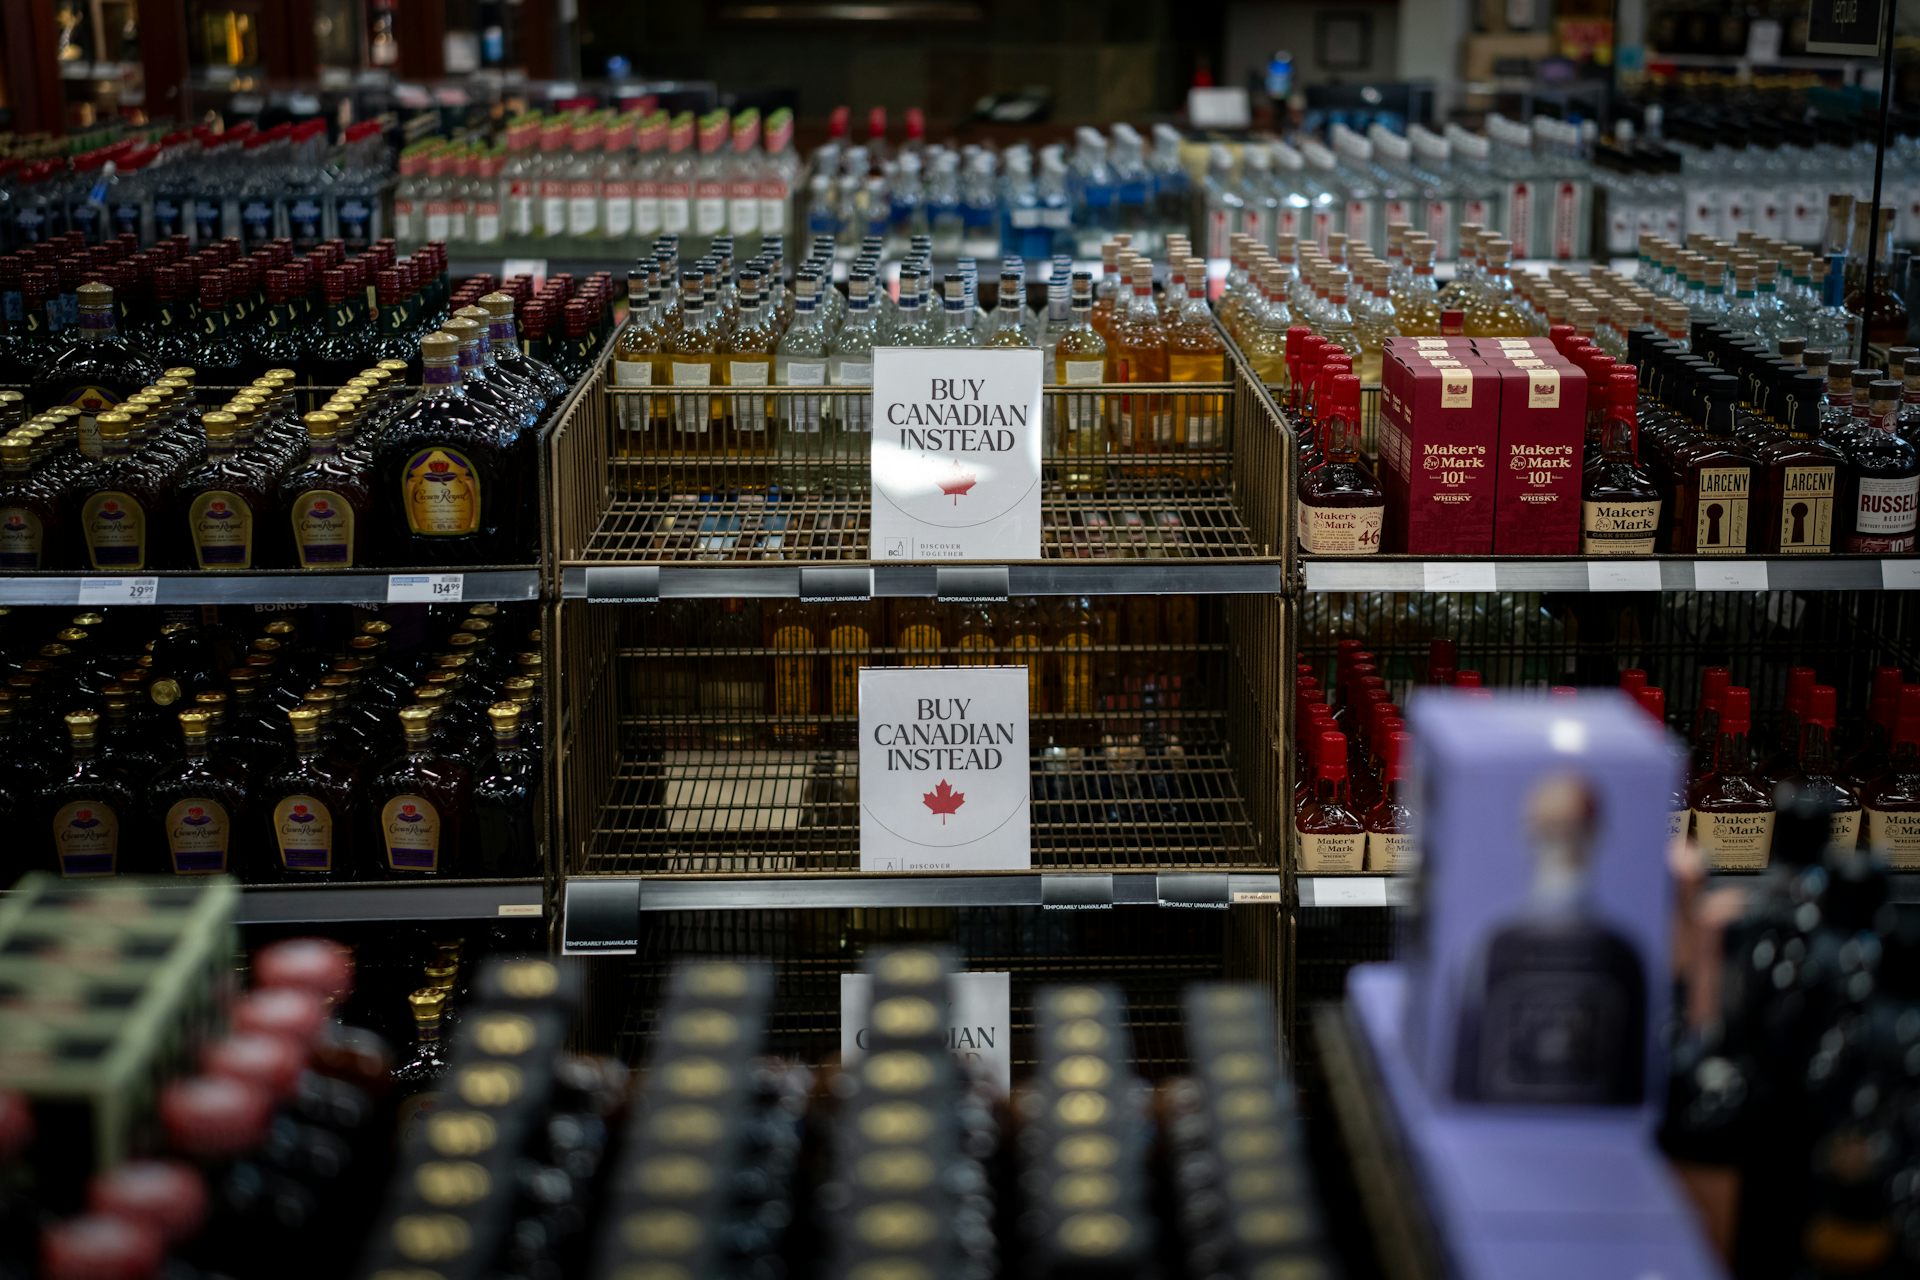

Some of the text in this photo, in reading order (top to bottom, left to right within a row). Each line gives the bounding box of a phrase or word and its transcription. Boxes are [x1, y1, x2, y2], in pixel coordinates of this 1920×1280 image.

[931, 378, 985, 401] BUY
[887, 403, 1028, 426] CANADIAN
[900, 428, 1015, 452] INSTEAD
[1423, 444, 1486, 455] Maker's
[1510, 444, 1573, 455] Maker's
[1440, 457, 1485, 468] Mark
[1527, 457, 1572, 468] Mark
[1441, 471, 1466, 484] 101
[1528, 471, 1553, 484] 101
[1701, 474, 1748, 492] LARCENY
[1785, 472, 1834, 491] LARCENY
[1314, 511, 1357, 520] Maker's
[1597, 507, 1655, 518] Maker's
[1325, 521, 1355, 529] Mark
[1612, 519, 1653, 530] Mark
[1358, 528, 1380, 545] 46
[917, 698, 971, 720] BUY
[874, 723, 1015, 746] CANADIAN
[887, 748, 1003, 771] INSTEAD
[1713, 815, 1766, 824] Maker's
[1728, 826, 1765, 834] Mark
[855, 1027, 995, 1050] CIAN
